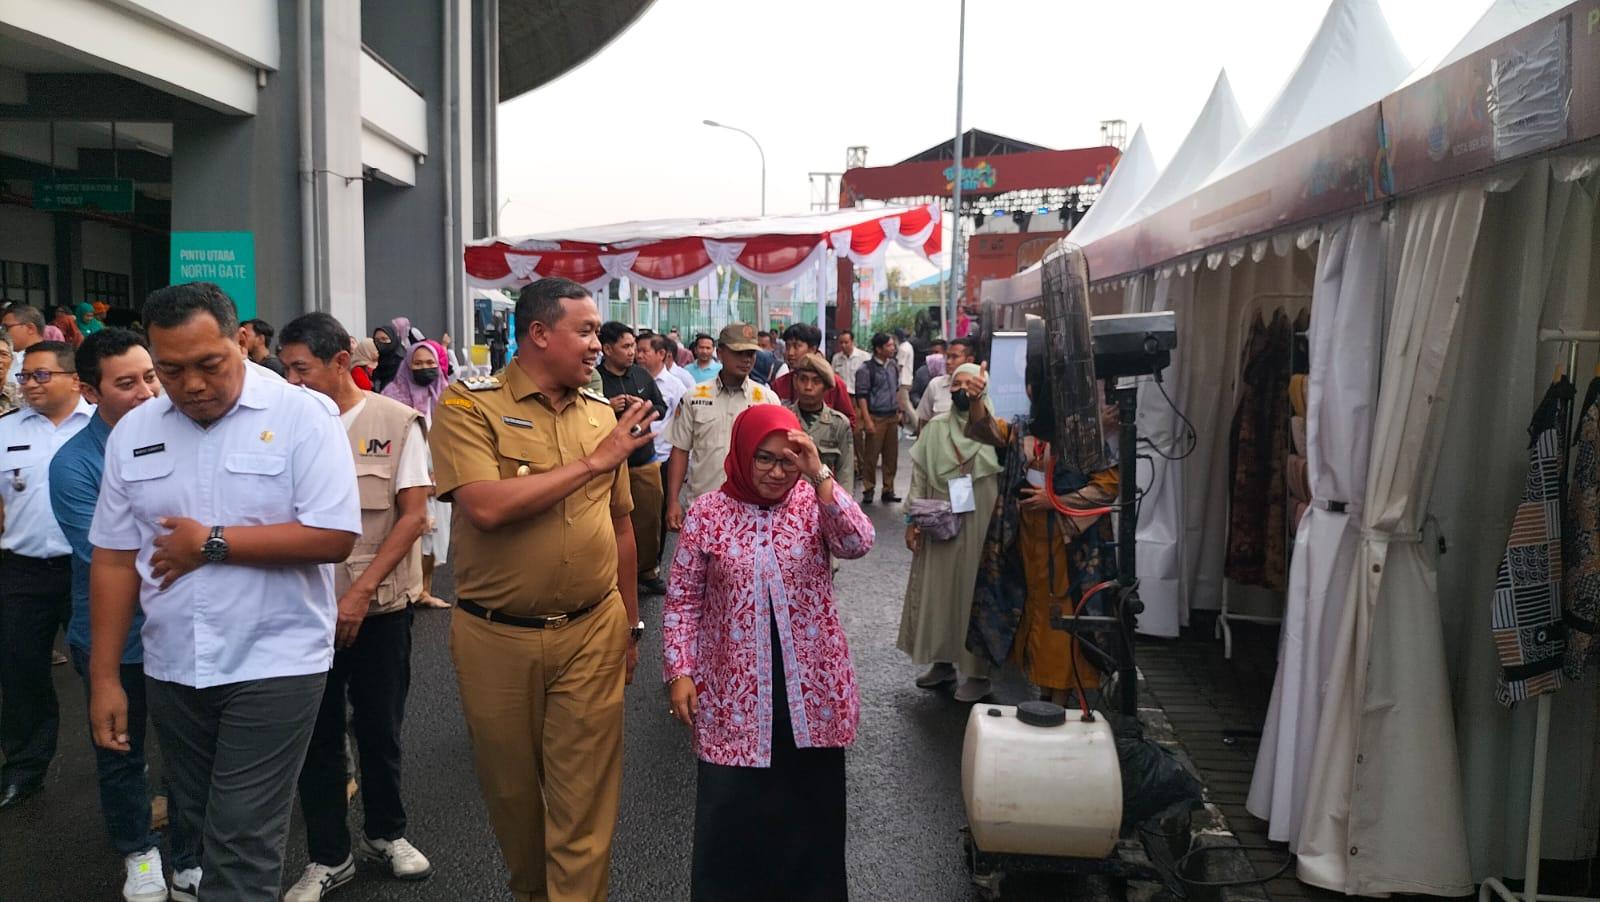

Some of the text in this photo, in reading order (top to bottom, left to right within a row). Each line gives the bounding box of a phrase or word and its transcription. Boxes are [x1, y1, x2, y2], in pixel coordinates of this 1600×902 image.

[180, 249, 235, 261] PINTU UTARA
[181, 264, 247, 278] NORTH GATE
